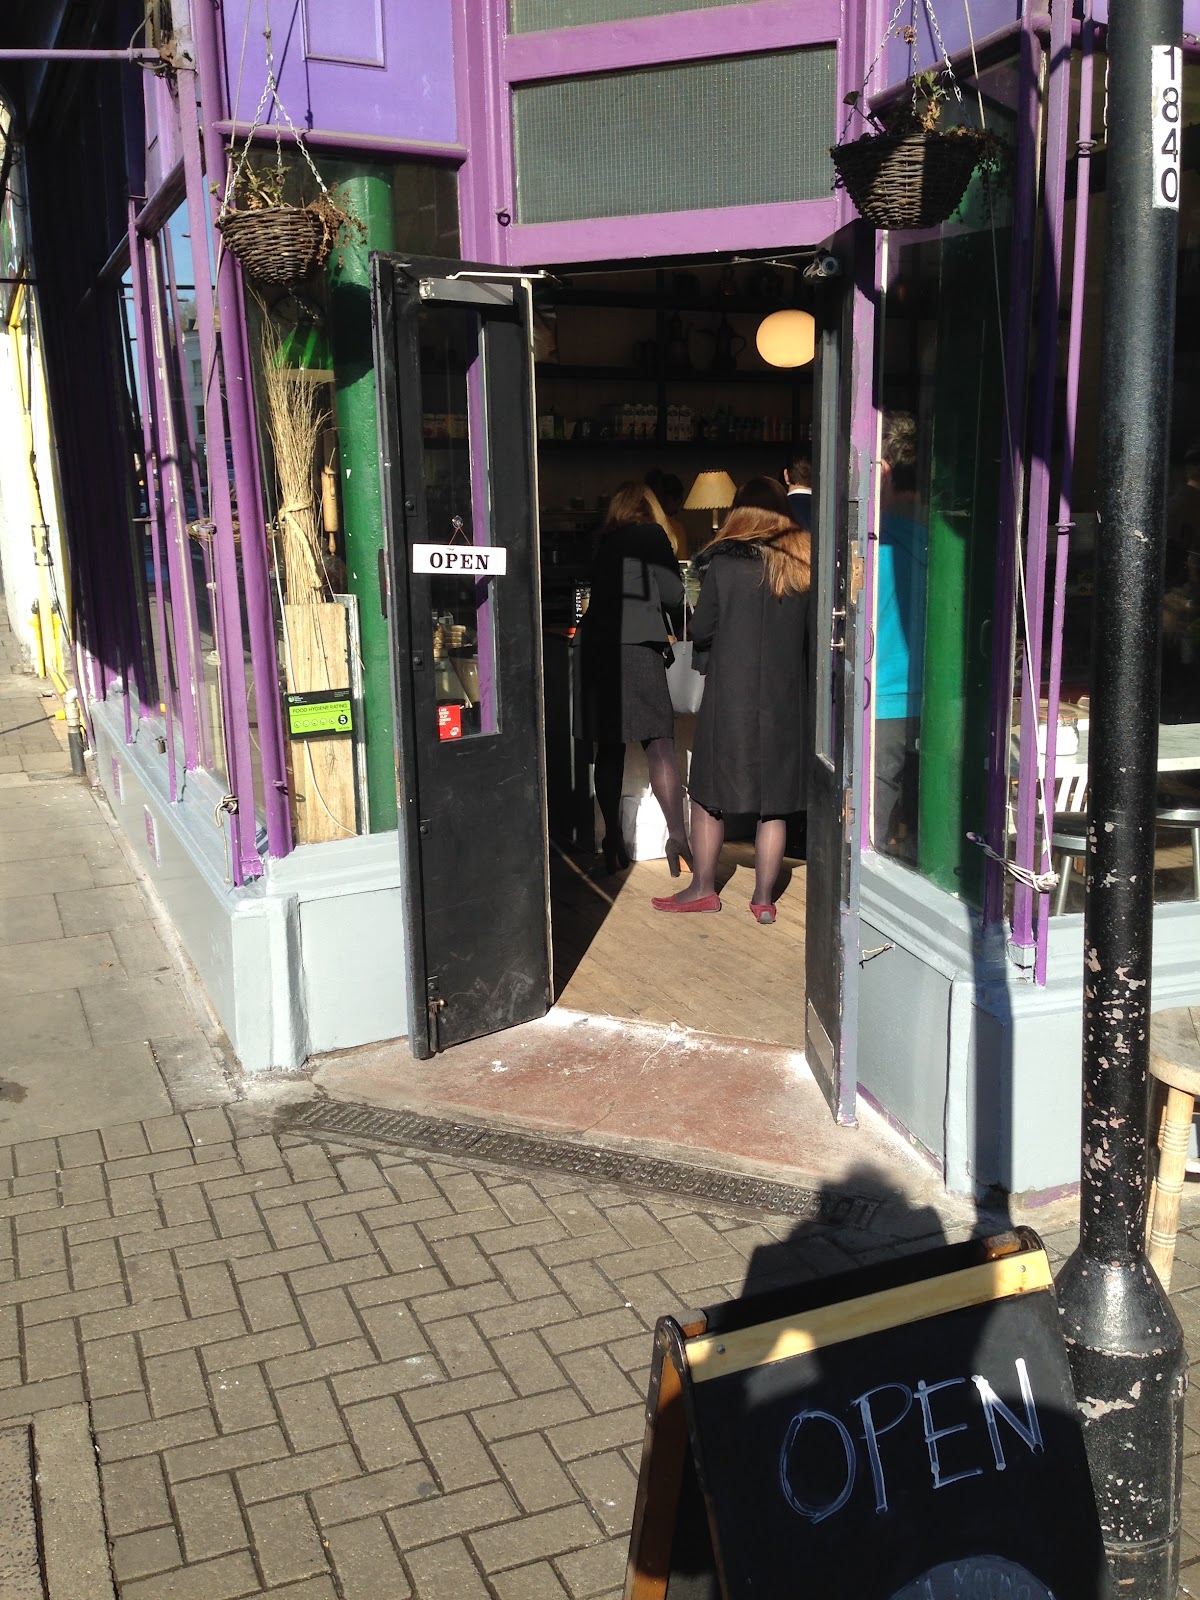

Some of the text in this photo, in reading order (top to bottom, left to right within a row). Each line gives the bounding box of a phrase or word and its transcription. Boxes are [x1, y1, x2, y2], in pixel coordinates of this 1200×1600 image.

[1161, 46, 1179, 203] 1840
[430, 552, 490, 570] OPEN
[779, 1357, 1045, 1525] OPEN
